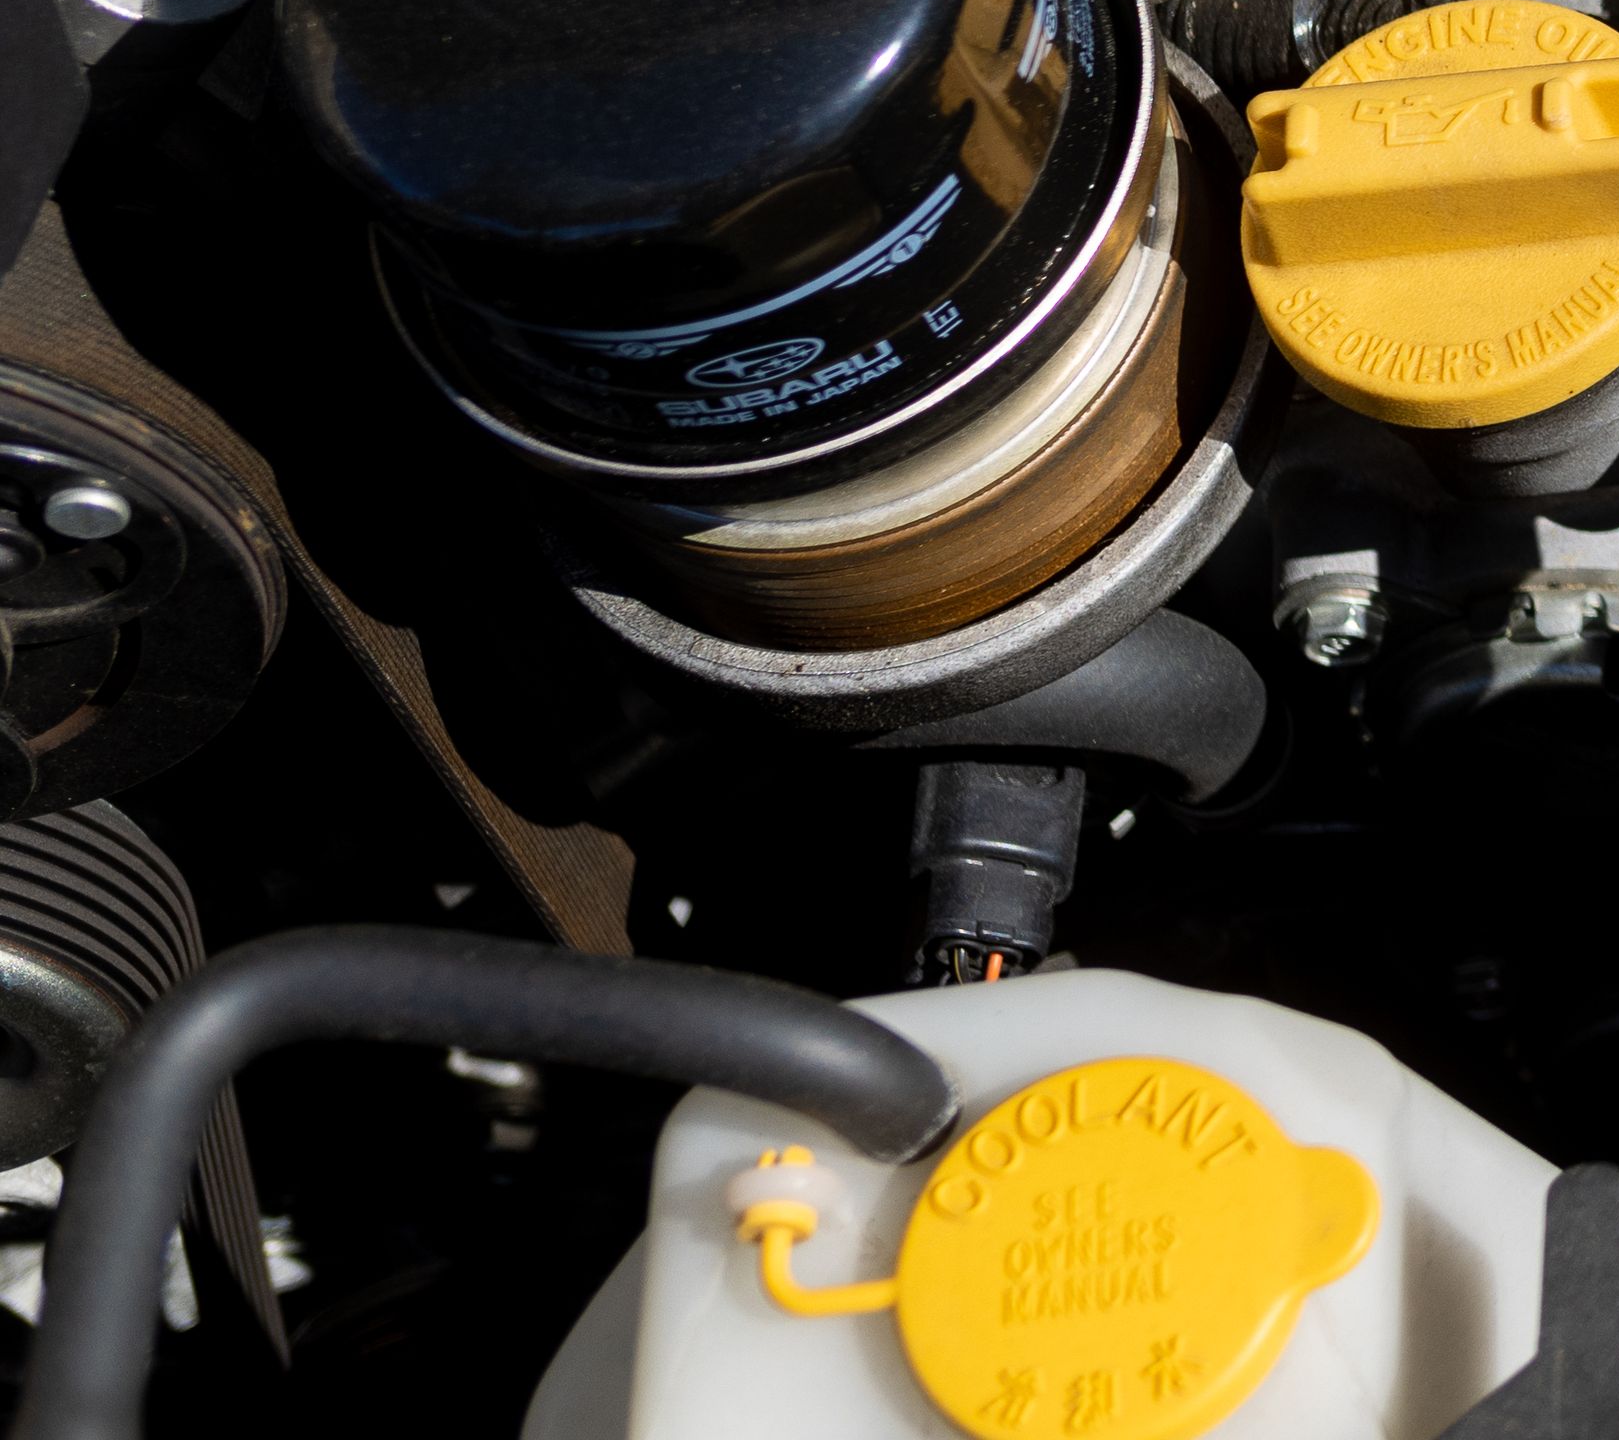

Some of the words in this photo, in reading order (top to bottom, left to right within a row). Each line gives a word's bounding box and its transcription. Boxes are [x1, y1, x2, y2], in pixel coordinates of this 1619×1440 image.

[1277, 285, 1339, 350] SEE
[1336, 328, 1499, 384] OWNER'S
[655, 338, 895, 416] SUBARU
[666, 410, 755, 429] MADE
[764, 399, 799, 418] IN
[804, 355, 903, 407] JAPAN
[928, 1073, 1258, 1219] COOLANT
[1031, 1181, 1117, 1231] SEE
[1001, 1261, 1171, 1326] MANUAL
